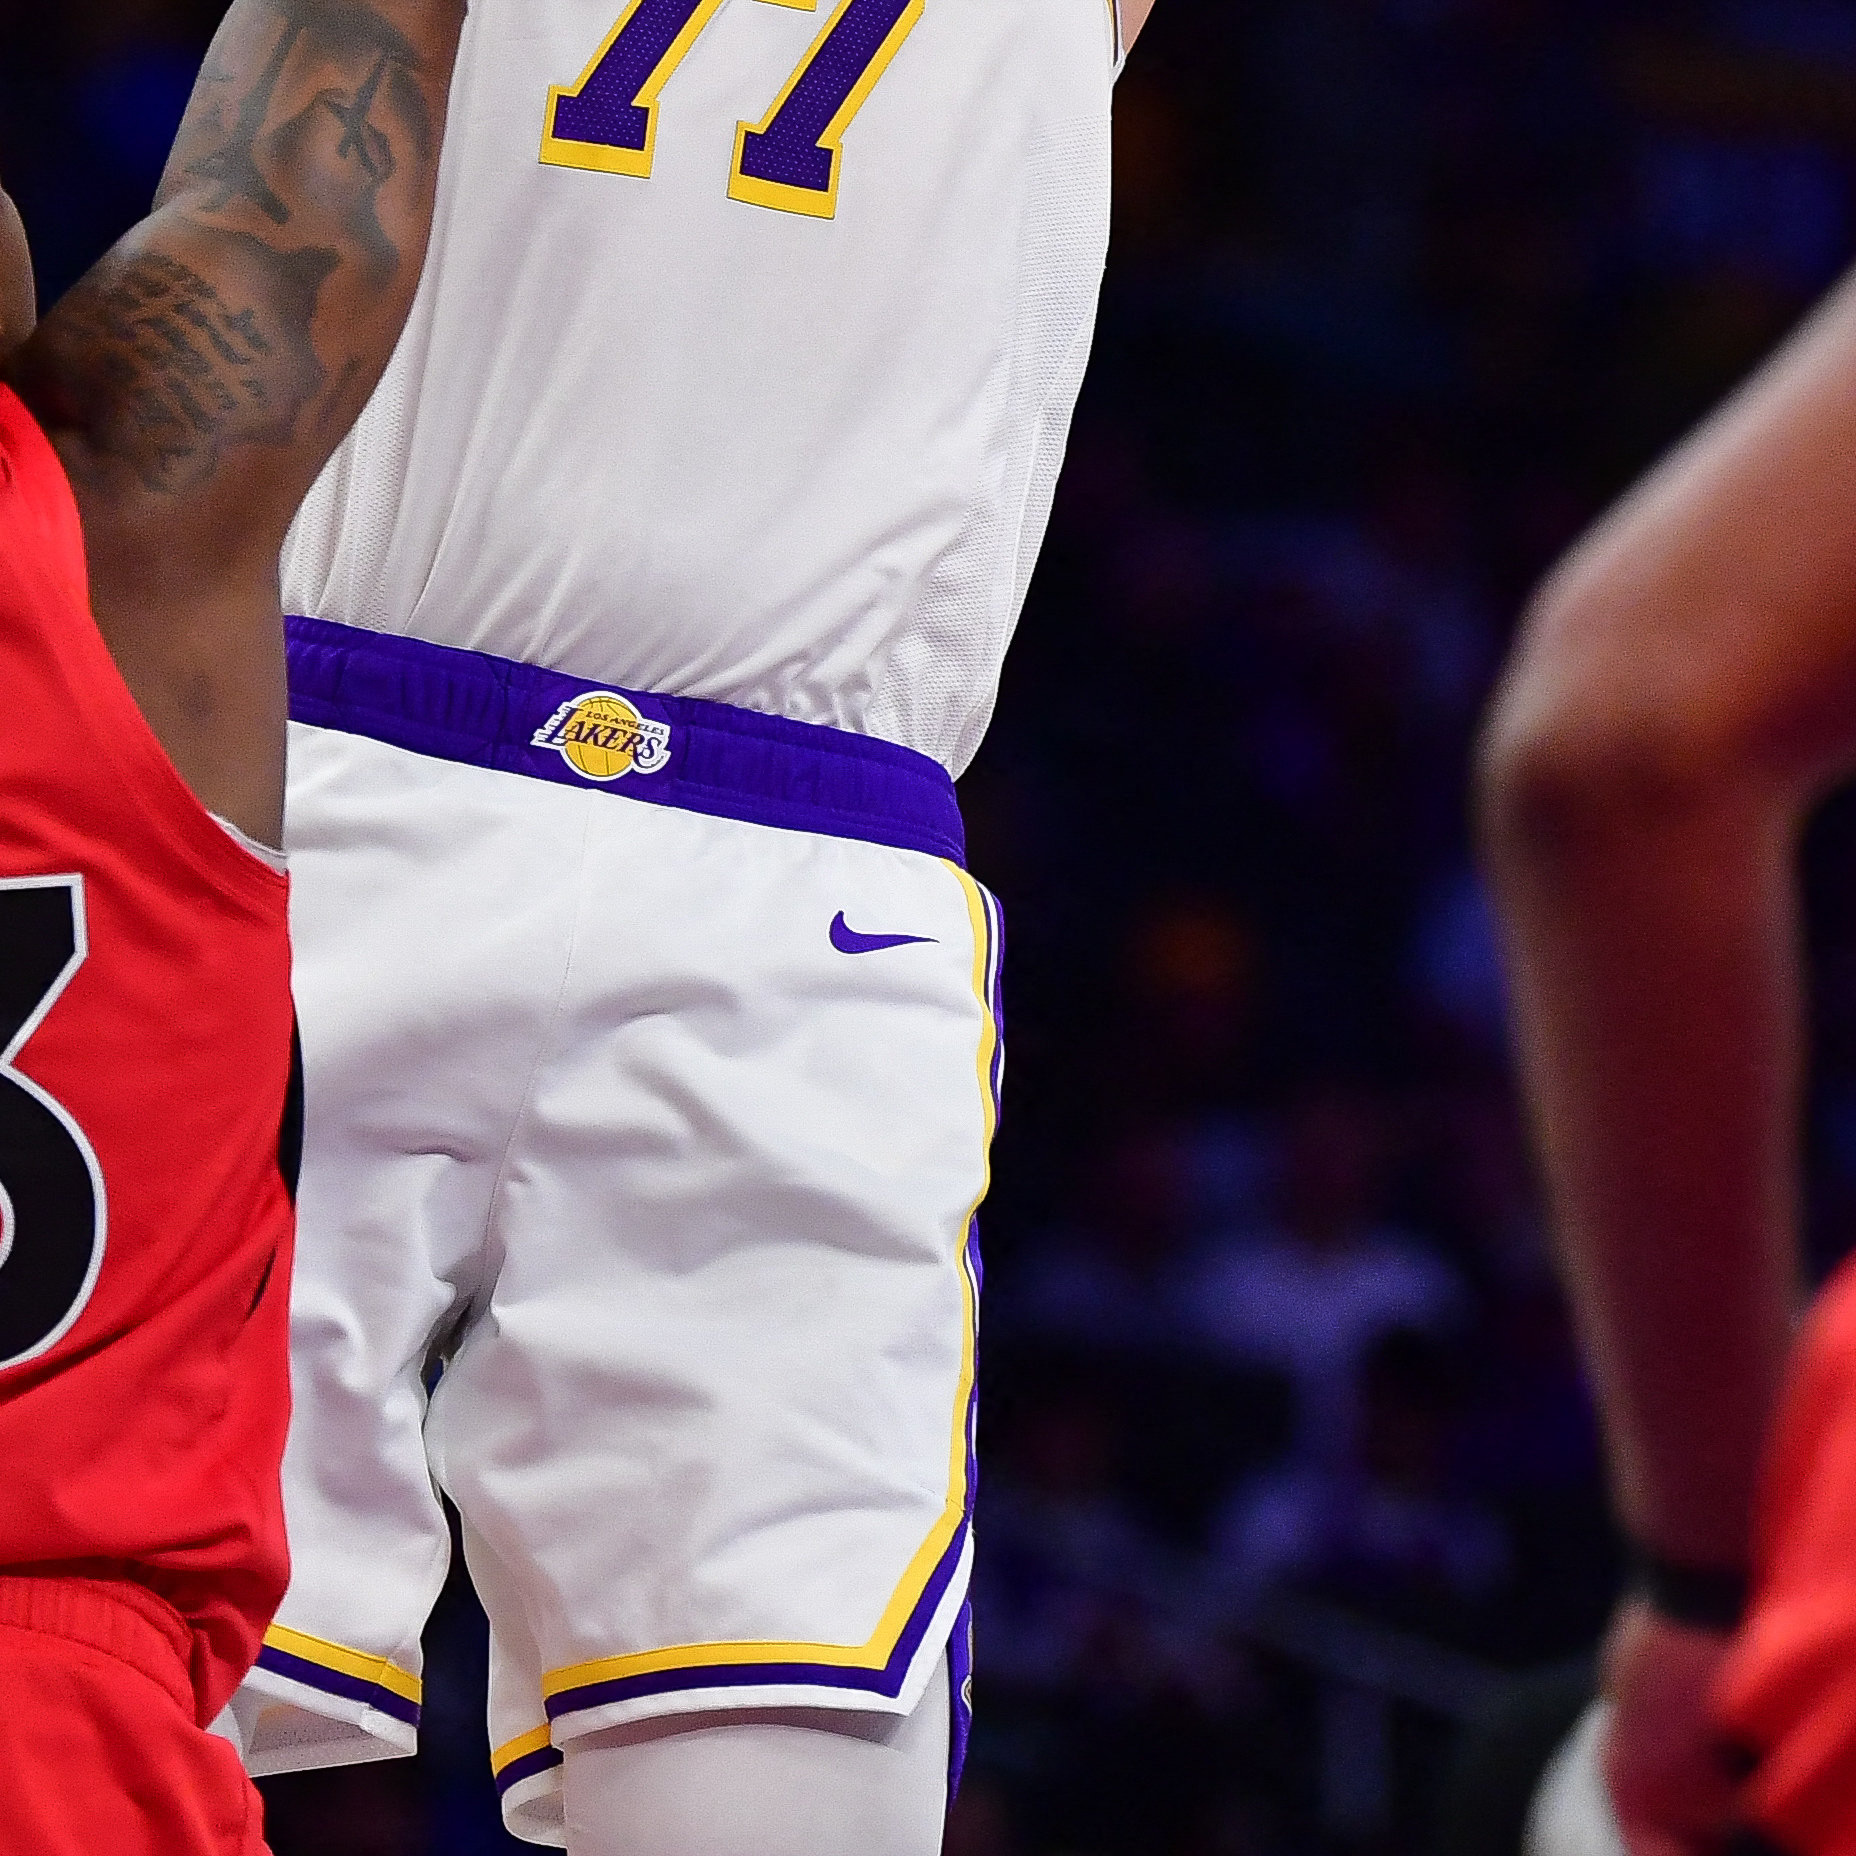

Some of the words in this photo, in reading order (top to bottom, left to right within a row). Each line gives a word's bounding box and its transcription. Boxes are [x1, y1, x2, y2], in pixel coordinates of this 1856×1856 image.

[540, 707, 665, 770] LAKERS
[585, 710, 609, 722] LOS
[609, 716, 665, 736] ANGELES
